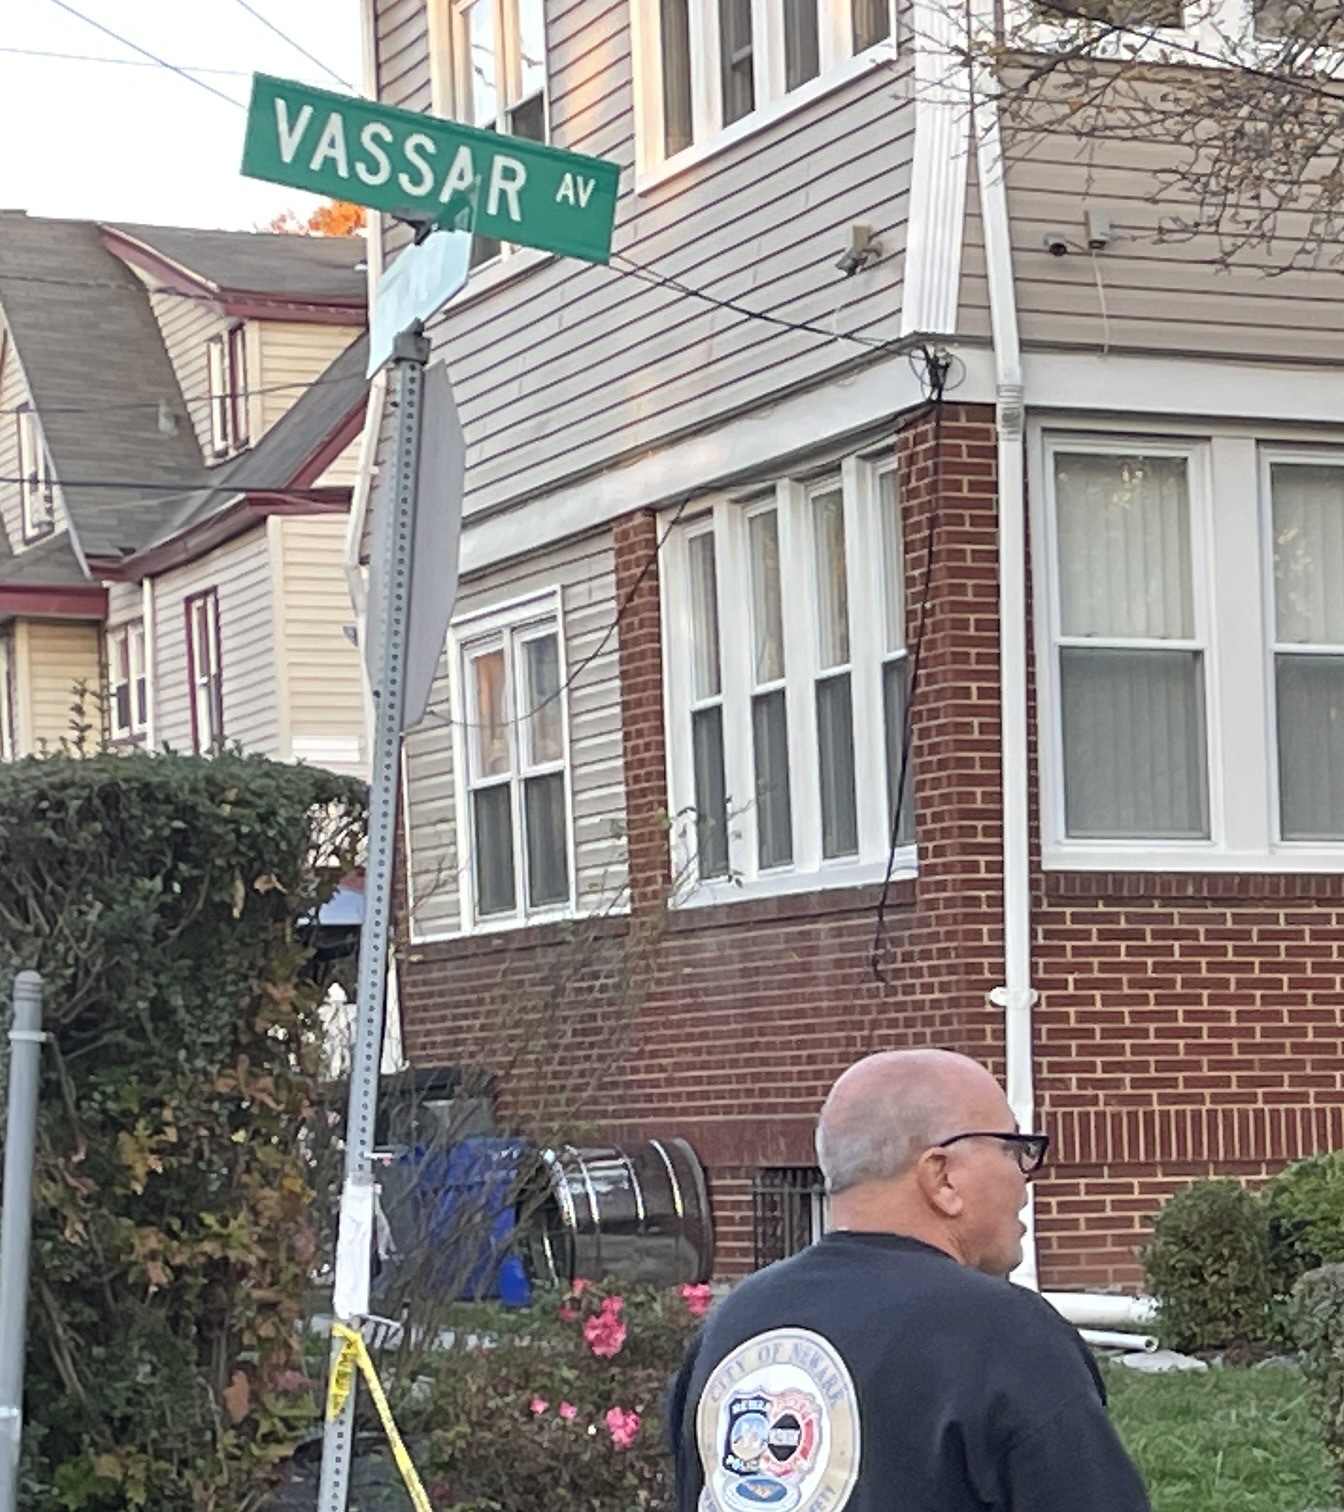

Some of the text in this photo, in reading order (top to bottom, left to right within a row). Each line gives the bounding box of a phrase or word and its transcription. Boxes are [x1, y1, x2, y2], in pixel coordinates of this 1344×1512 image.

[274, 97, 597, 223] VASSAR AV
[711, 1356, 747, 1402] CITY
[757, 1342, 784, 1365] OF
